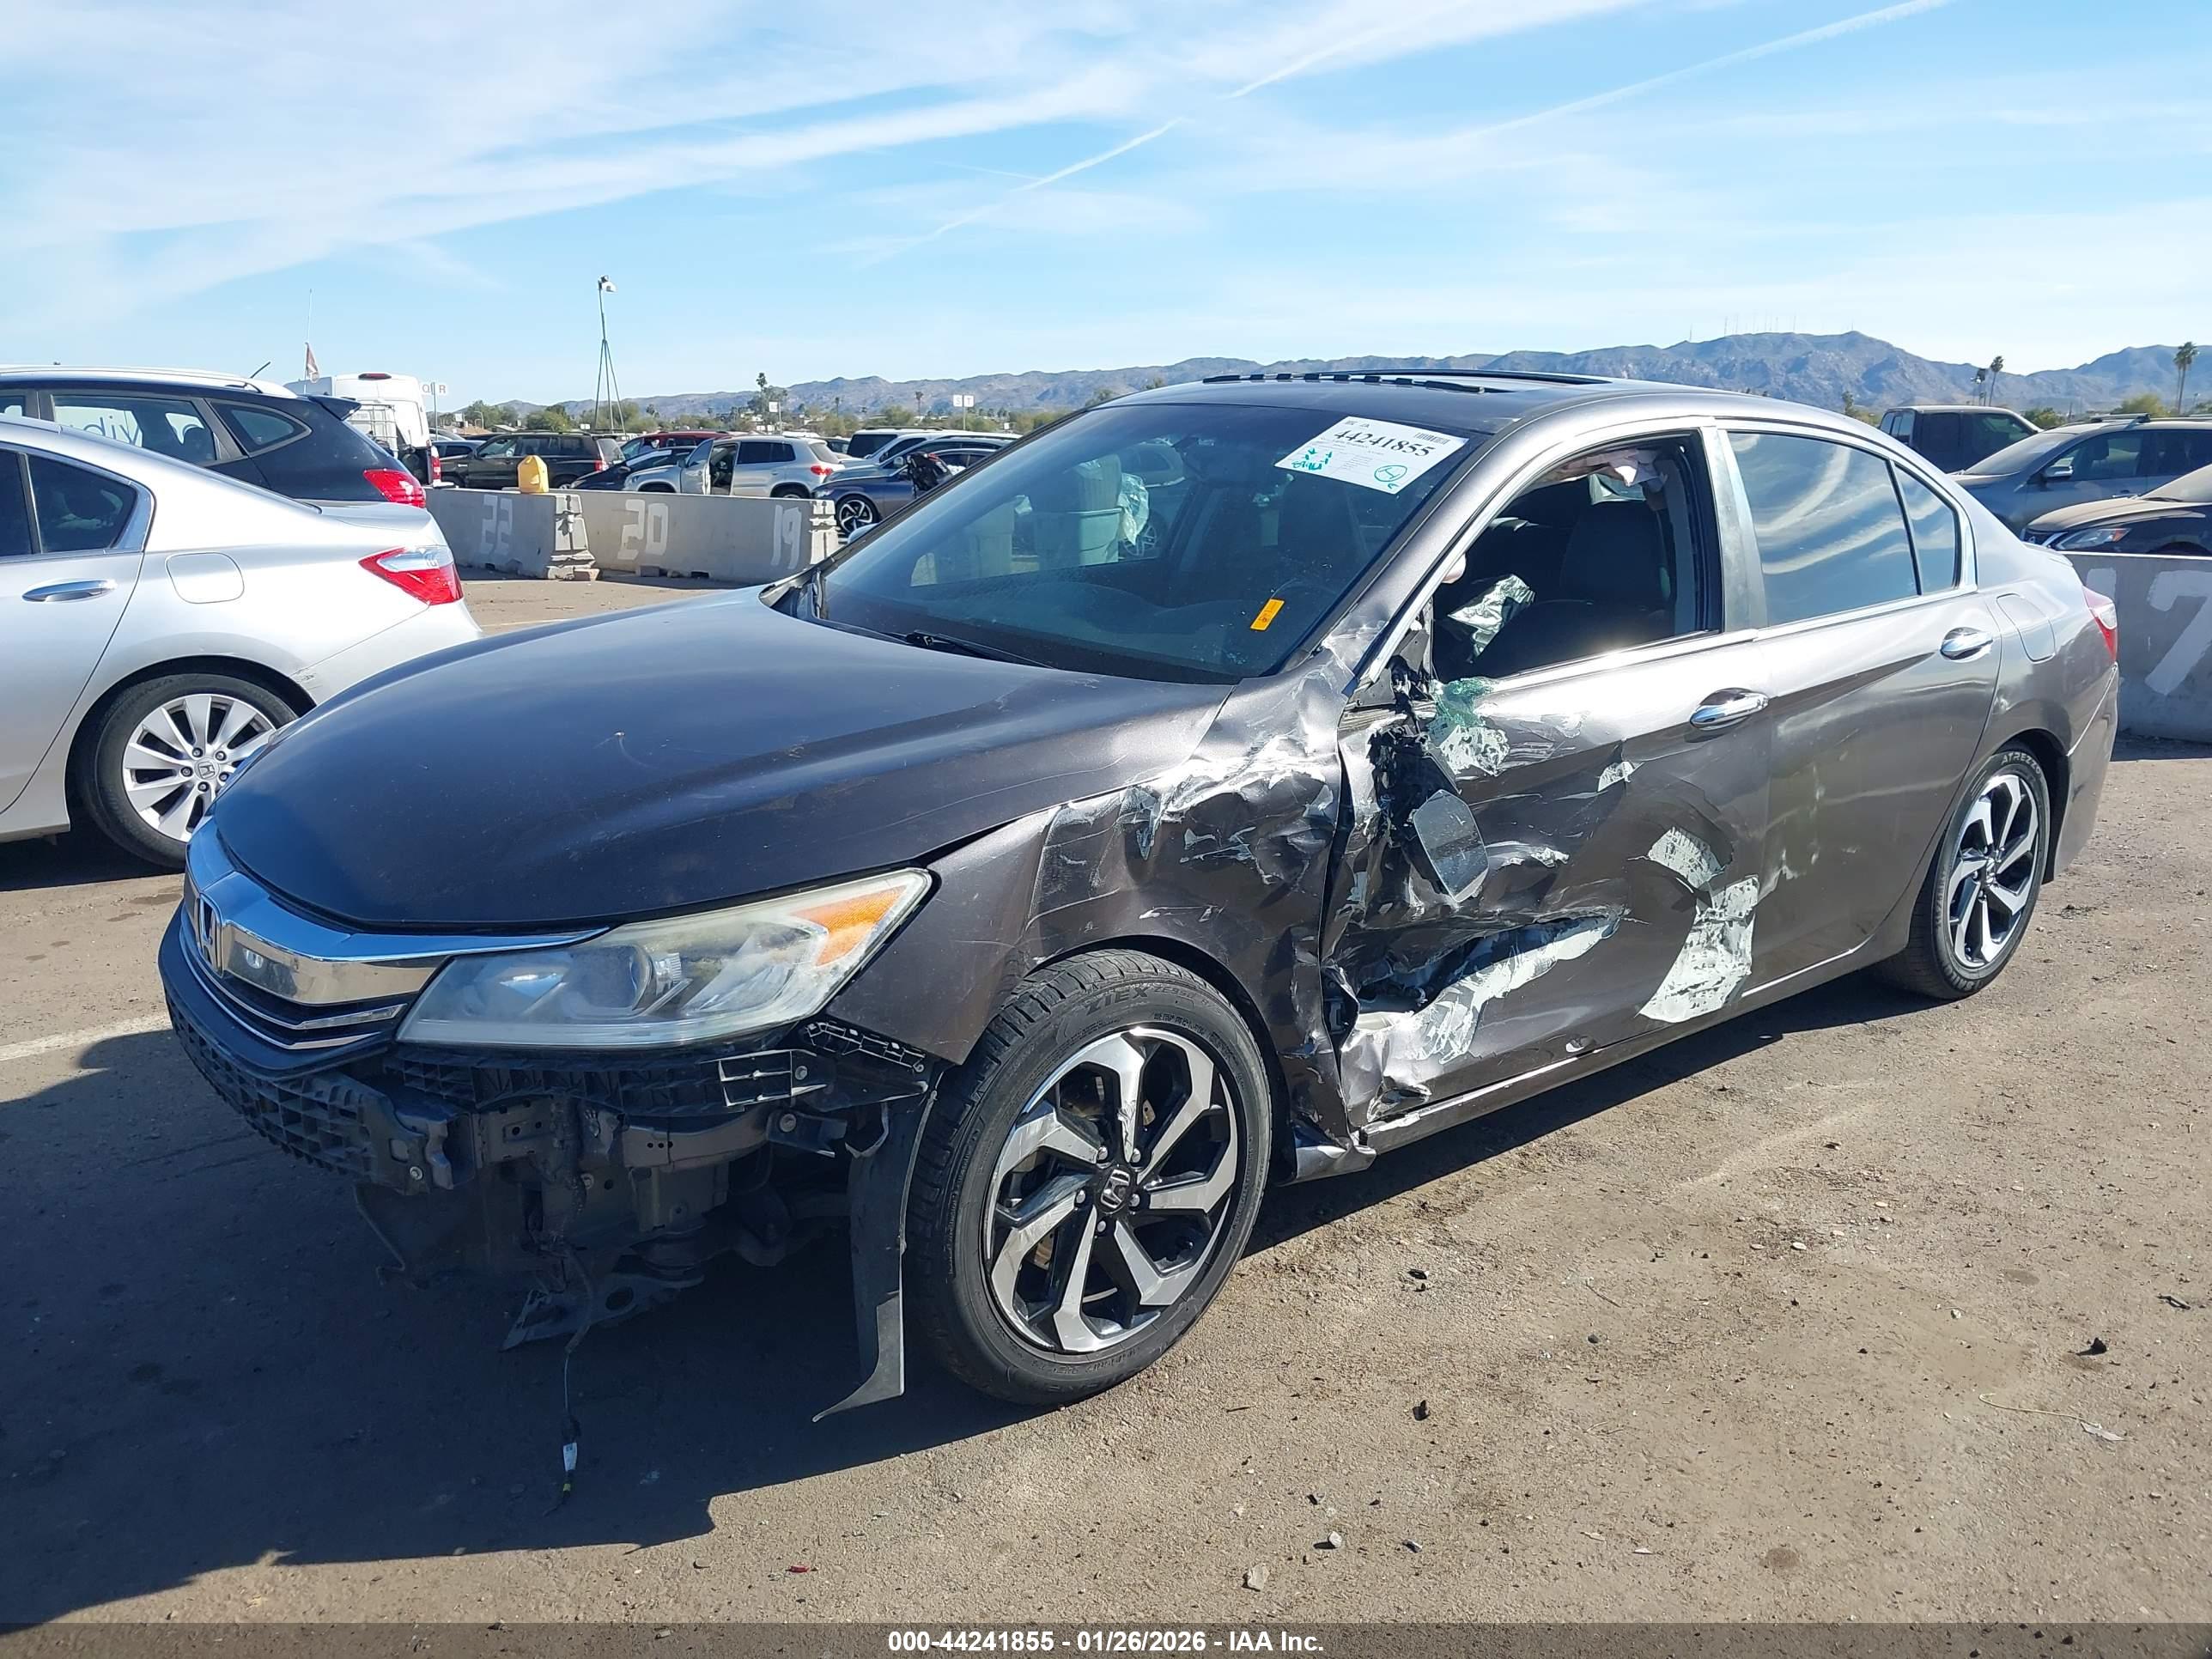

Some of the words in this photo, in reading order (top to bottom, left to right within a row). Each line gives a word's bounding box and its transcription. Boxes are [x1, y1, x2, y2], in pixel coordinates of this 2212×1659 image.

[422, 384, 431, 393] Q
[439, 384, 447, 394] R
[1334, 429, 1437, 457] 44241855
[479, 495, 514, 556] 22
[617, 499, 669, 561] 20
[770, 504, 802, 570] 19
[2001, 750, 2042, 775] ATREZZO
[1085, 986, 1148, 1015] ZIEX
